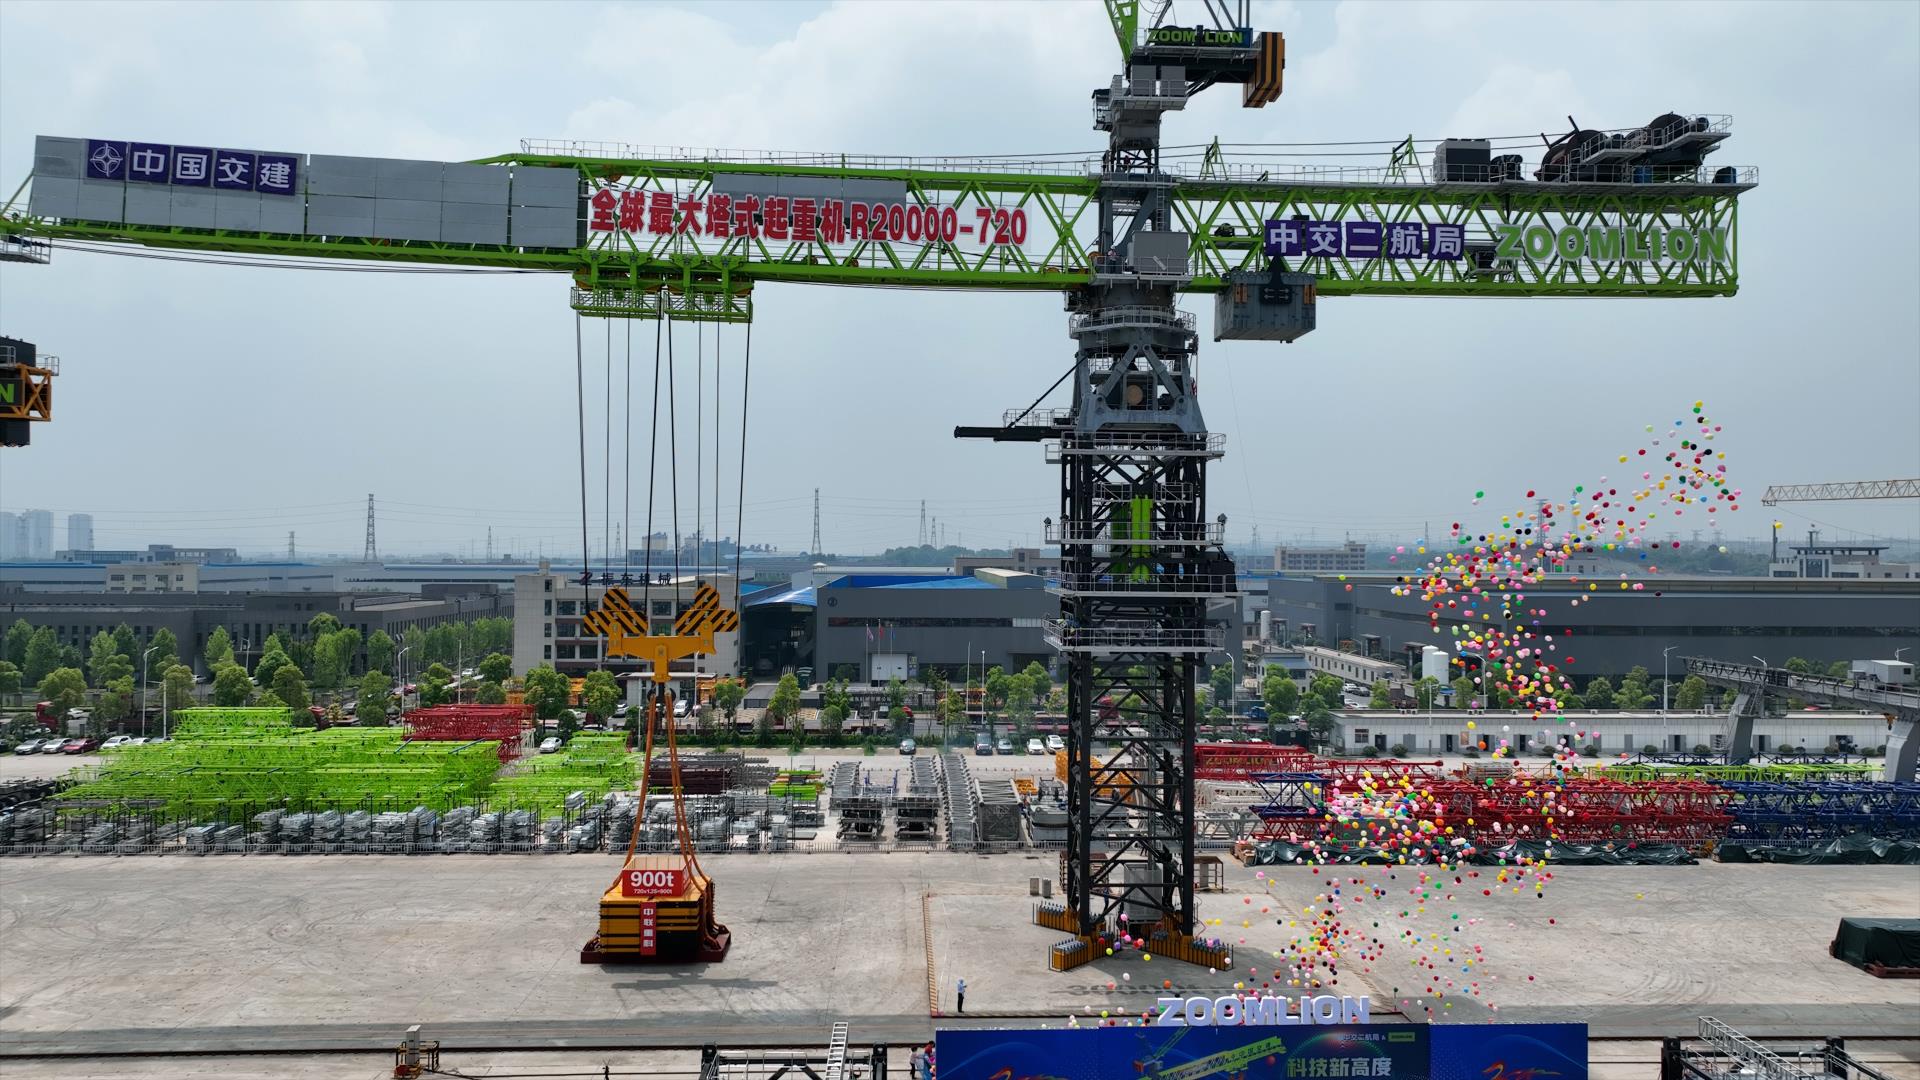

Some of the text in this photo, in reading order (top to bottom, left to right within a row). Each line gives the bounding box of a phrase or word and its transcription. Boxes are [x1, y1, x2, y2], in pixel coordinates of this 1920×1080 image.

[133, 149, 291, 188] 中国交建
[1270, 222, 1463, 258] 中交二航局
[1495, 224, 1729, 264] ZOOMLION
[630, 871, 675, 887] 900t
[1157, 995, 1370, 1027] ZOOMLION
[1287, 1057, 1392, 1078] 科技新高度
